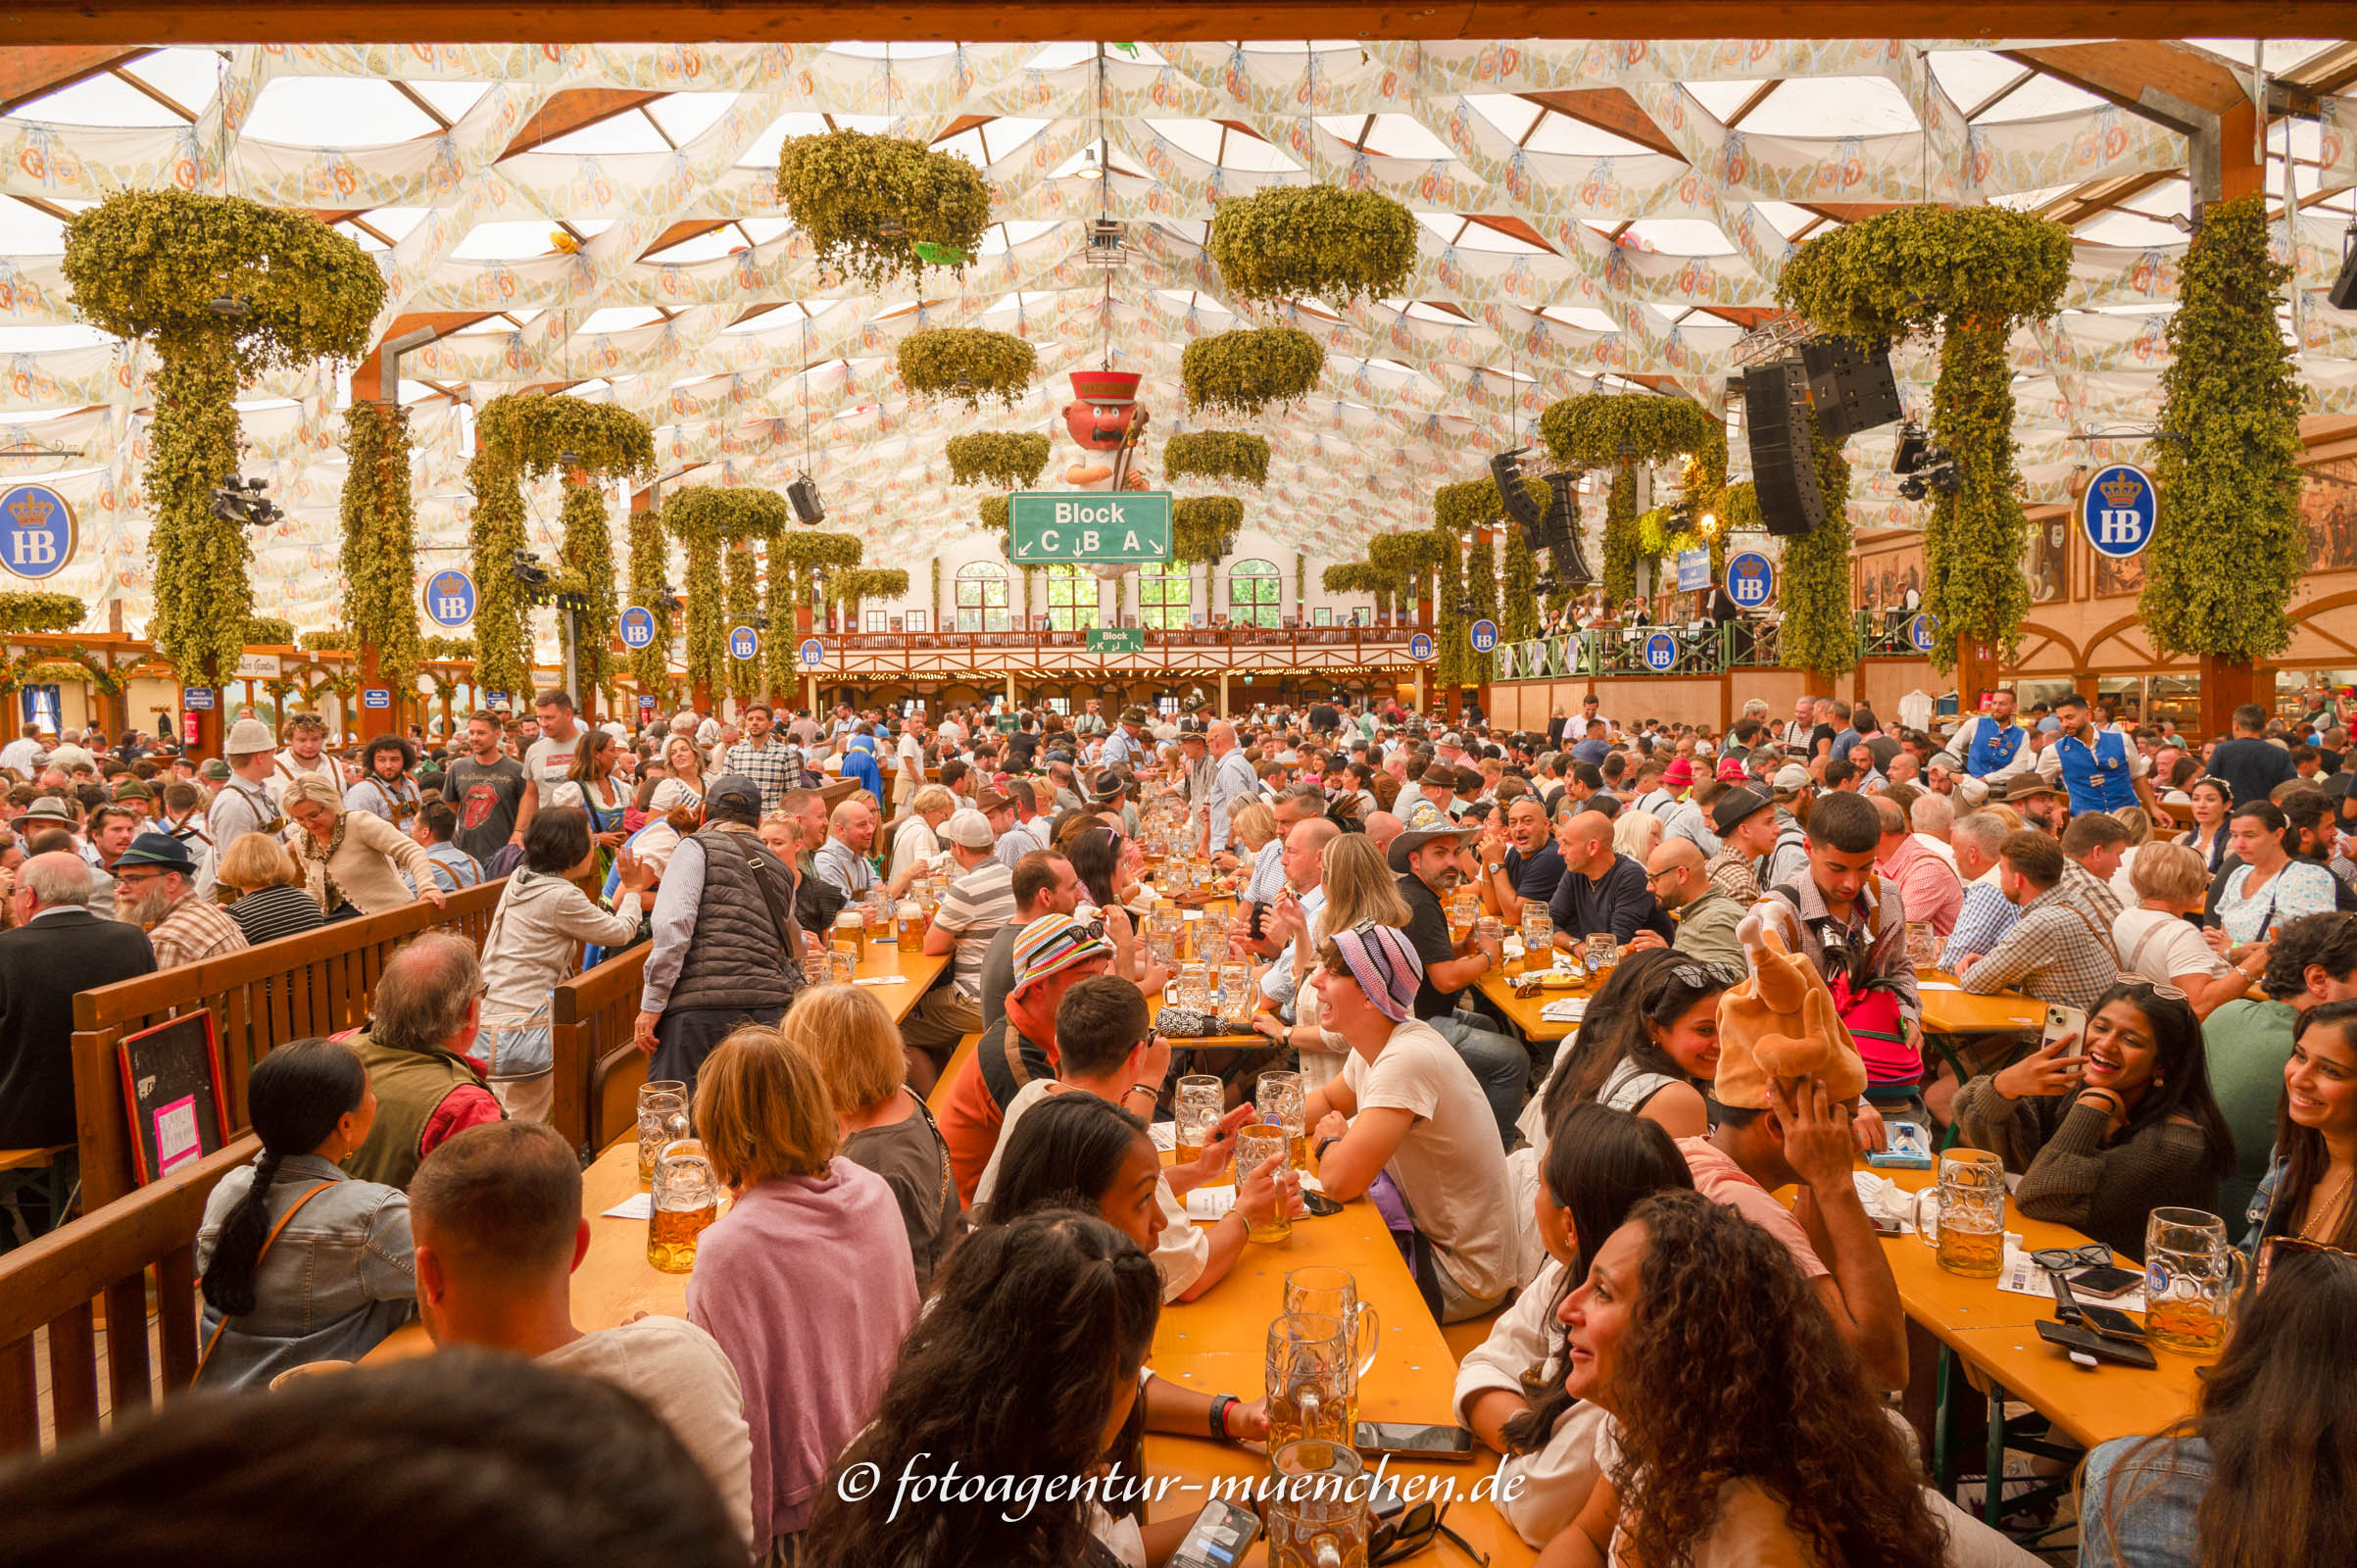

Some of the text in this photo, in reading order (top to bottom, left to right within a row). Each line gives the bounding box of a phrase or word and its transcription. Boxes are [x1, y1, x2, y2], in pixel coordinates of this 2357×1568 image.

[1055, 503, 1125, 523] Block
[2099, 510, 2141, 543] HB
[11, 530, 57, 564] HB
[1041, 530, 1141, 552] C B A
[1736, 578, 1764, 600] HB
[438, 597, 467, 619] HB
[626, 625, 648, 643] HB
[1103, 631, 1128, 640] Block
[1477, 634, 1493, 648] HB
[736, 642, 753, 656] HB
[805, 651, 819, 663] HB
[1414, 646, 1428, 657] HB
[1651, 650, 1670, 665] HB
